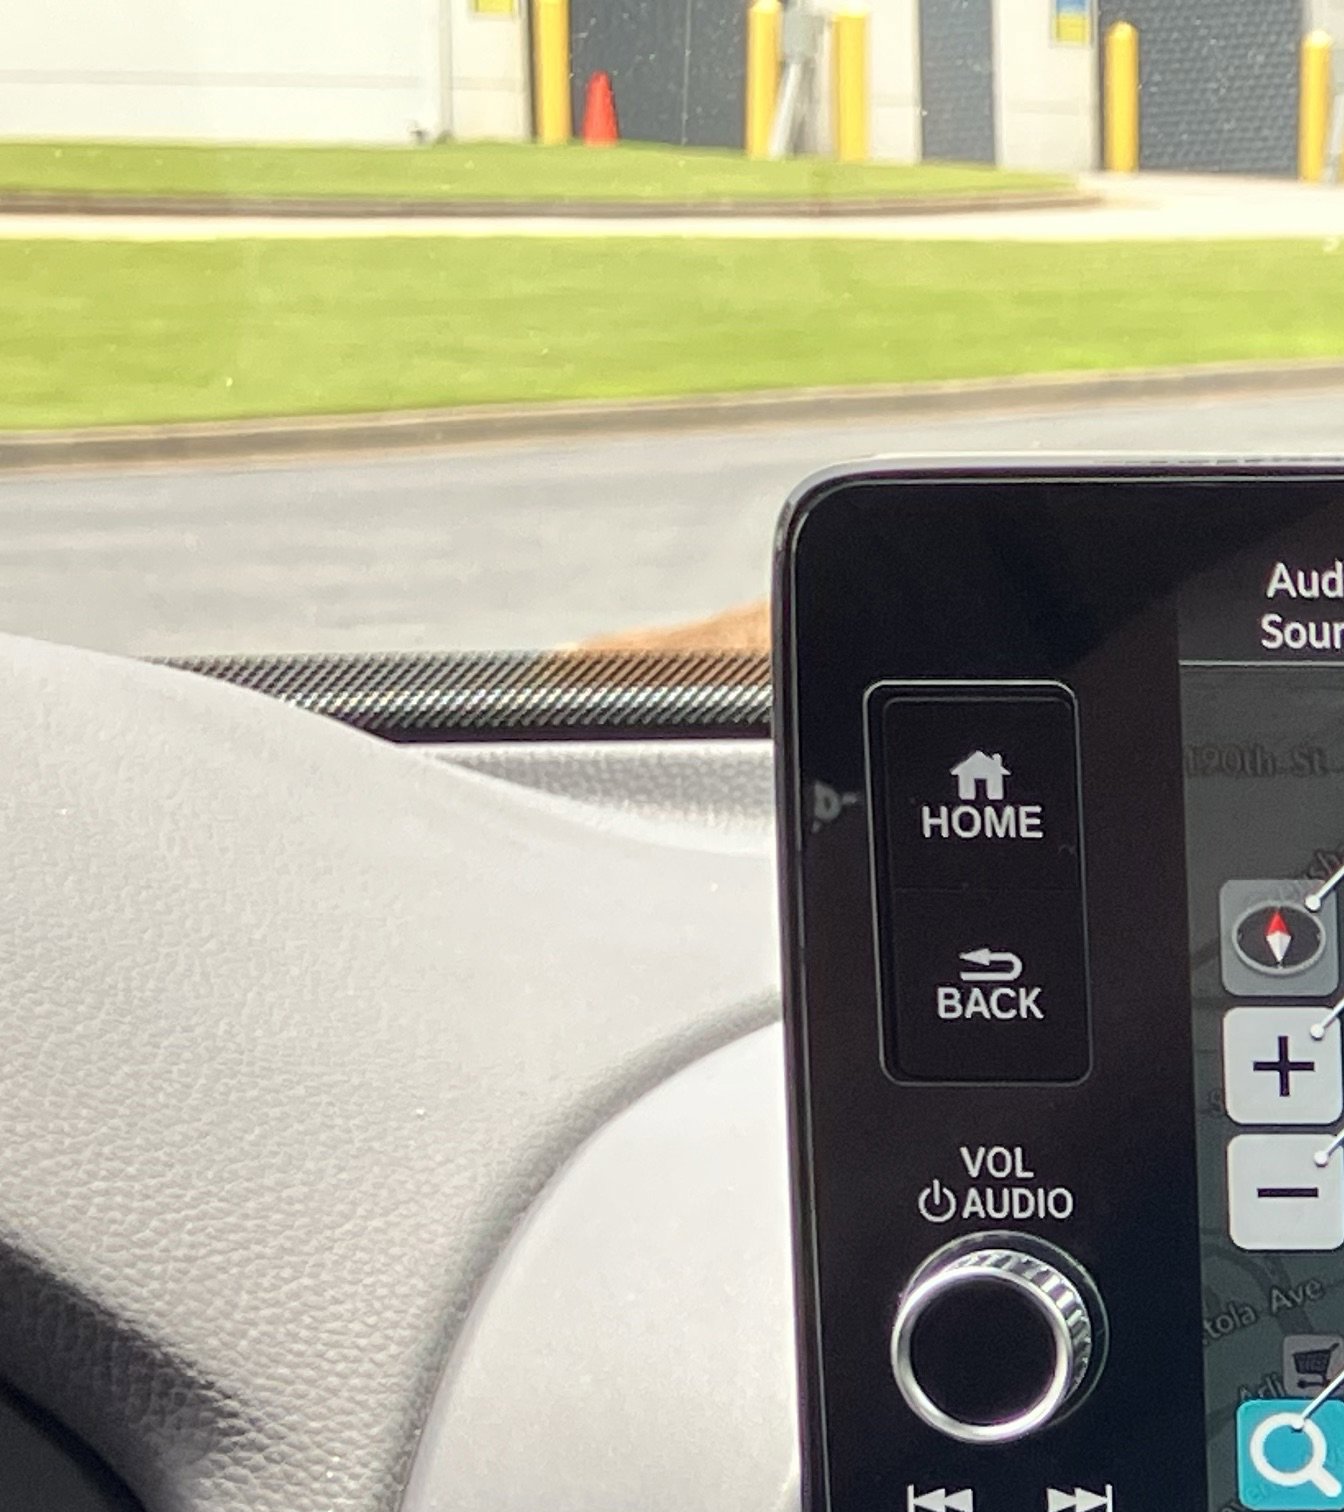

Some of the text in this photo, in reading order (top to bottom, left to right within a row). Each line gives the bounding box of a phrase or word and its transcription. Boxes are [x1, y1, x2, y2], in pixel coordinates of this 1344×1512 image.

[1292, 746, 1328, 776] St
[921, 804, 1044, 839] HOME
[936, 986, 1045, 1020] BACK
[960, 1145, 1035, 1179] VOL
[961, 1186, 1074, 1220] AUDIO
[1270, 1277, 1324, 1312] Ave
